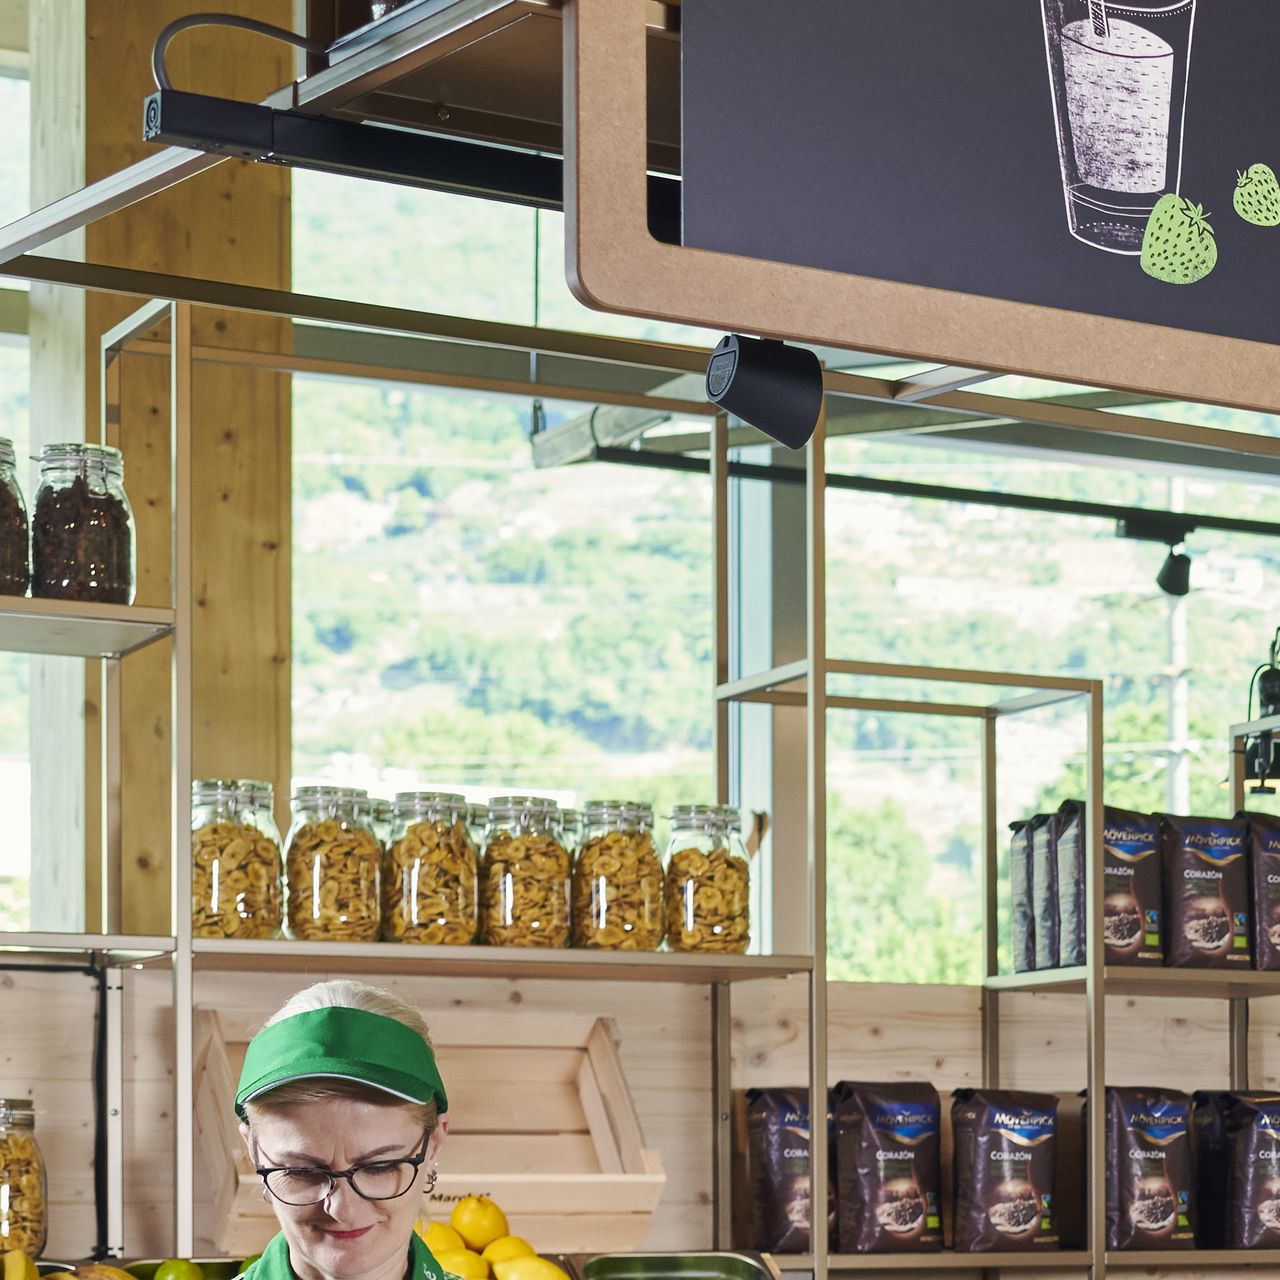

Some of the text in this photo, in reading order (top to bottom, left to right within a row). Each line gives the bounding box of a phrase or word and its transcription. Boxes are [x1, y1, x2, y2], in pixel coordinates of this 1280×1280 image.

[1103, 866, 1134, 876] ORAZÓN
[1184, 869, 1223, 879] CORAZÓN
[784, 1148, 809, 1159] CORA
[876, 1150, 915, 1161] CORAZÓN
[990, 1150, 1032, 1161] CORAZÓN
